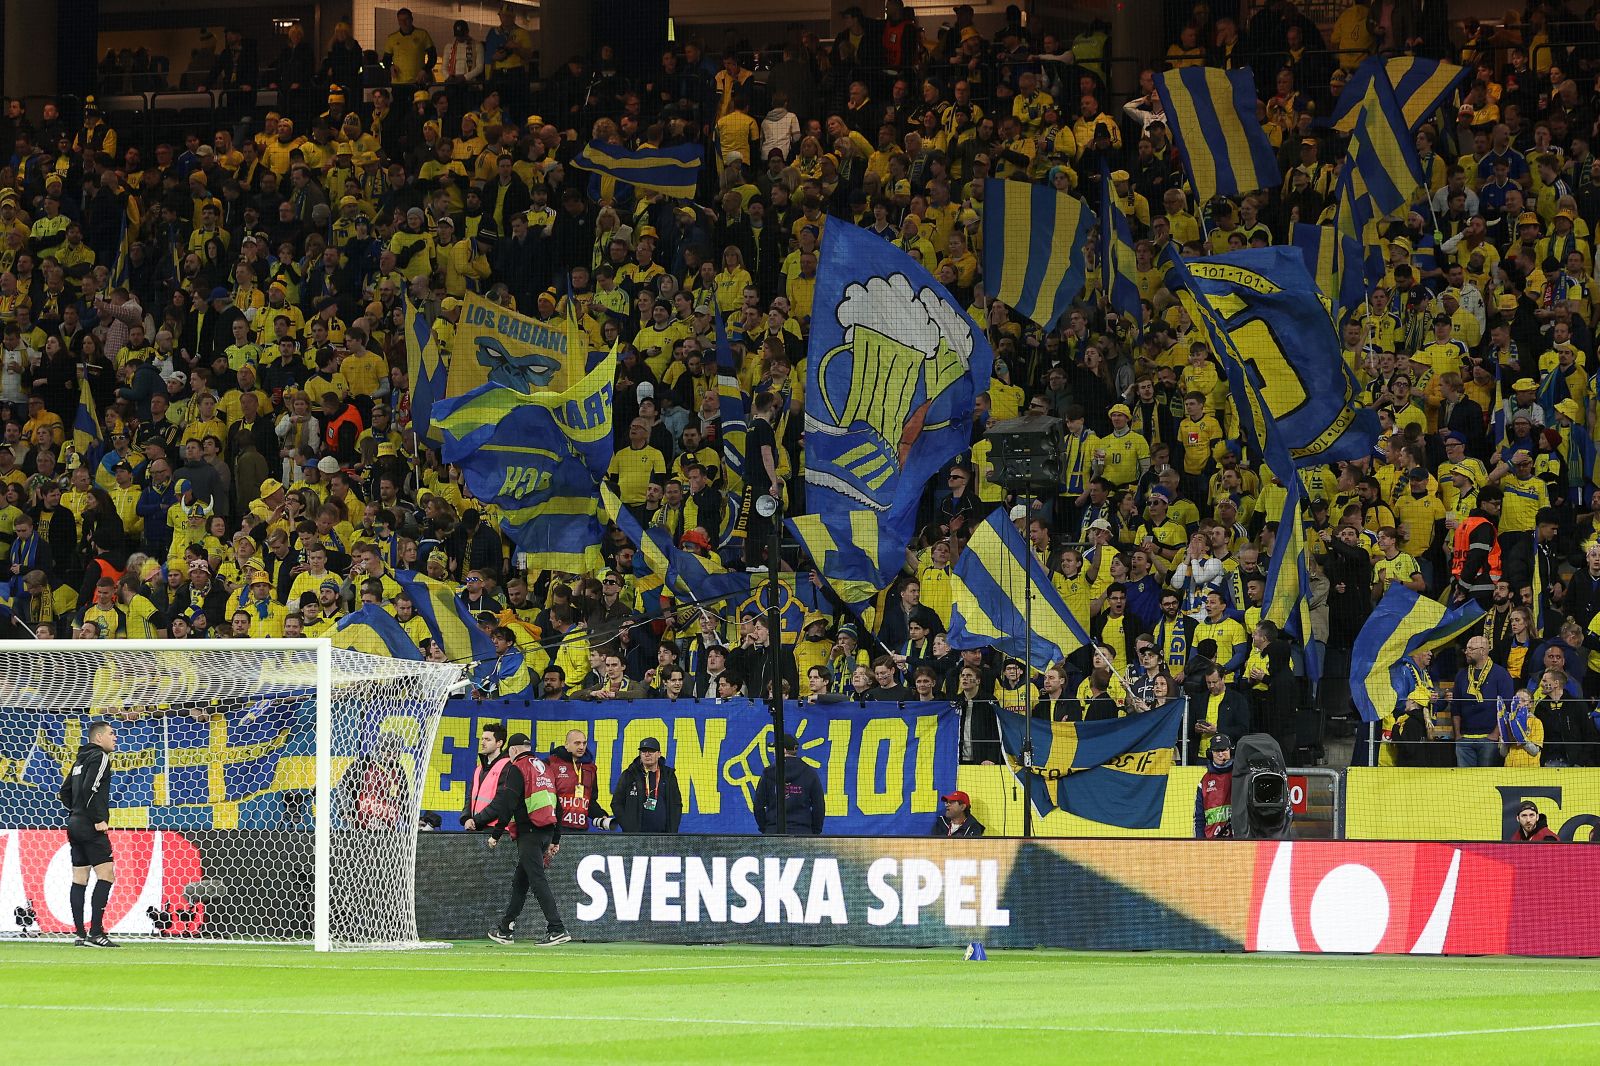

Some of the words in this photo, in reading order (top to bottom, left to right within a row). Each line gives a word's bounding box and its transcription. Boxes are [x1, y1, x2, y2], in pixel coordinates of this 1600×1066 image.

[465, 303, 495, 328] LOS
[1111, 452, 1121, 464] 10
[824, 715, 938, 817] 101
[563, 812, 586, 826] 418
[576, 854, 849, 925] SVENSKA
[867, 857, 1011, 927] SPEL
